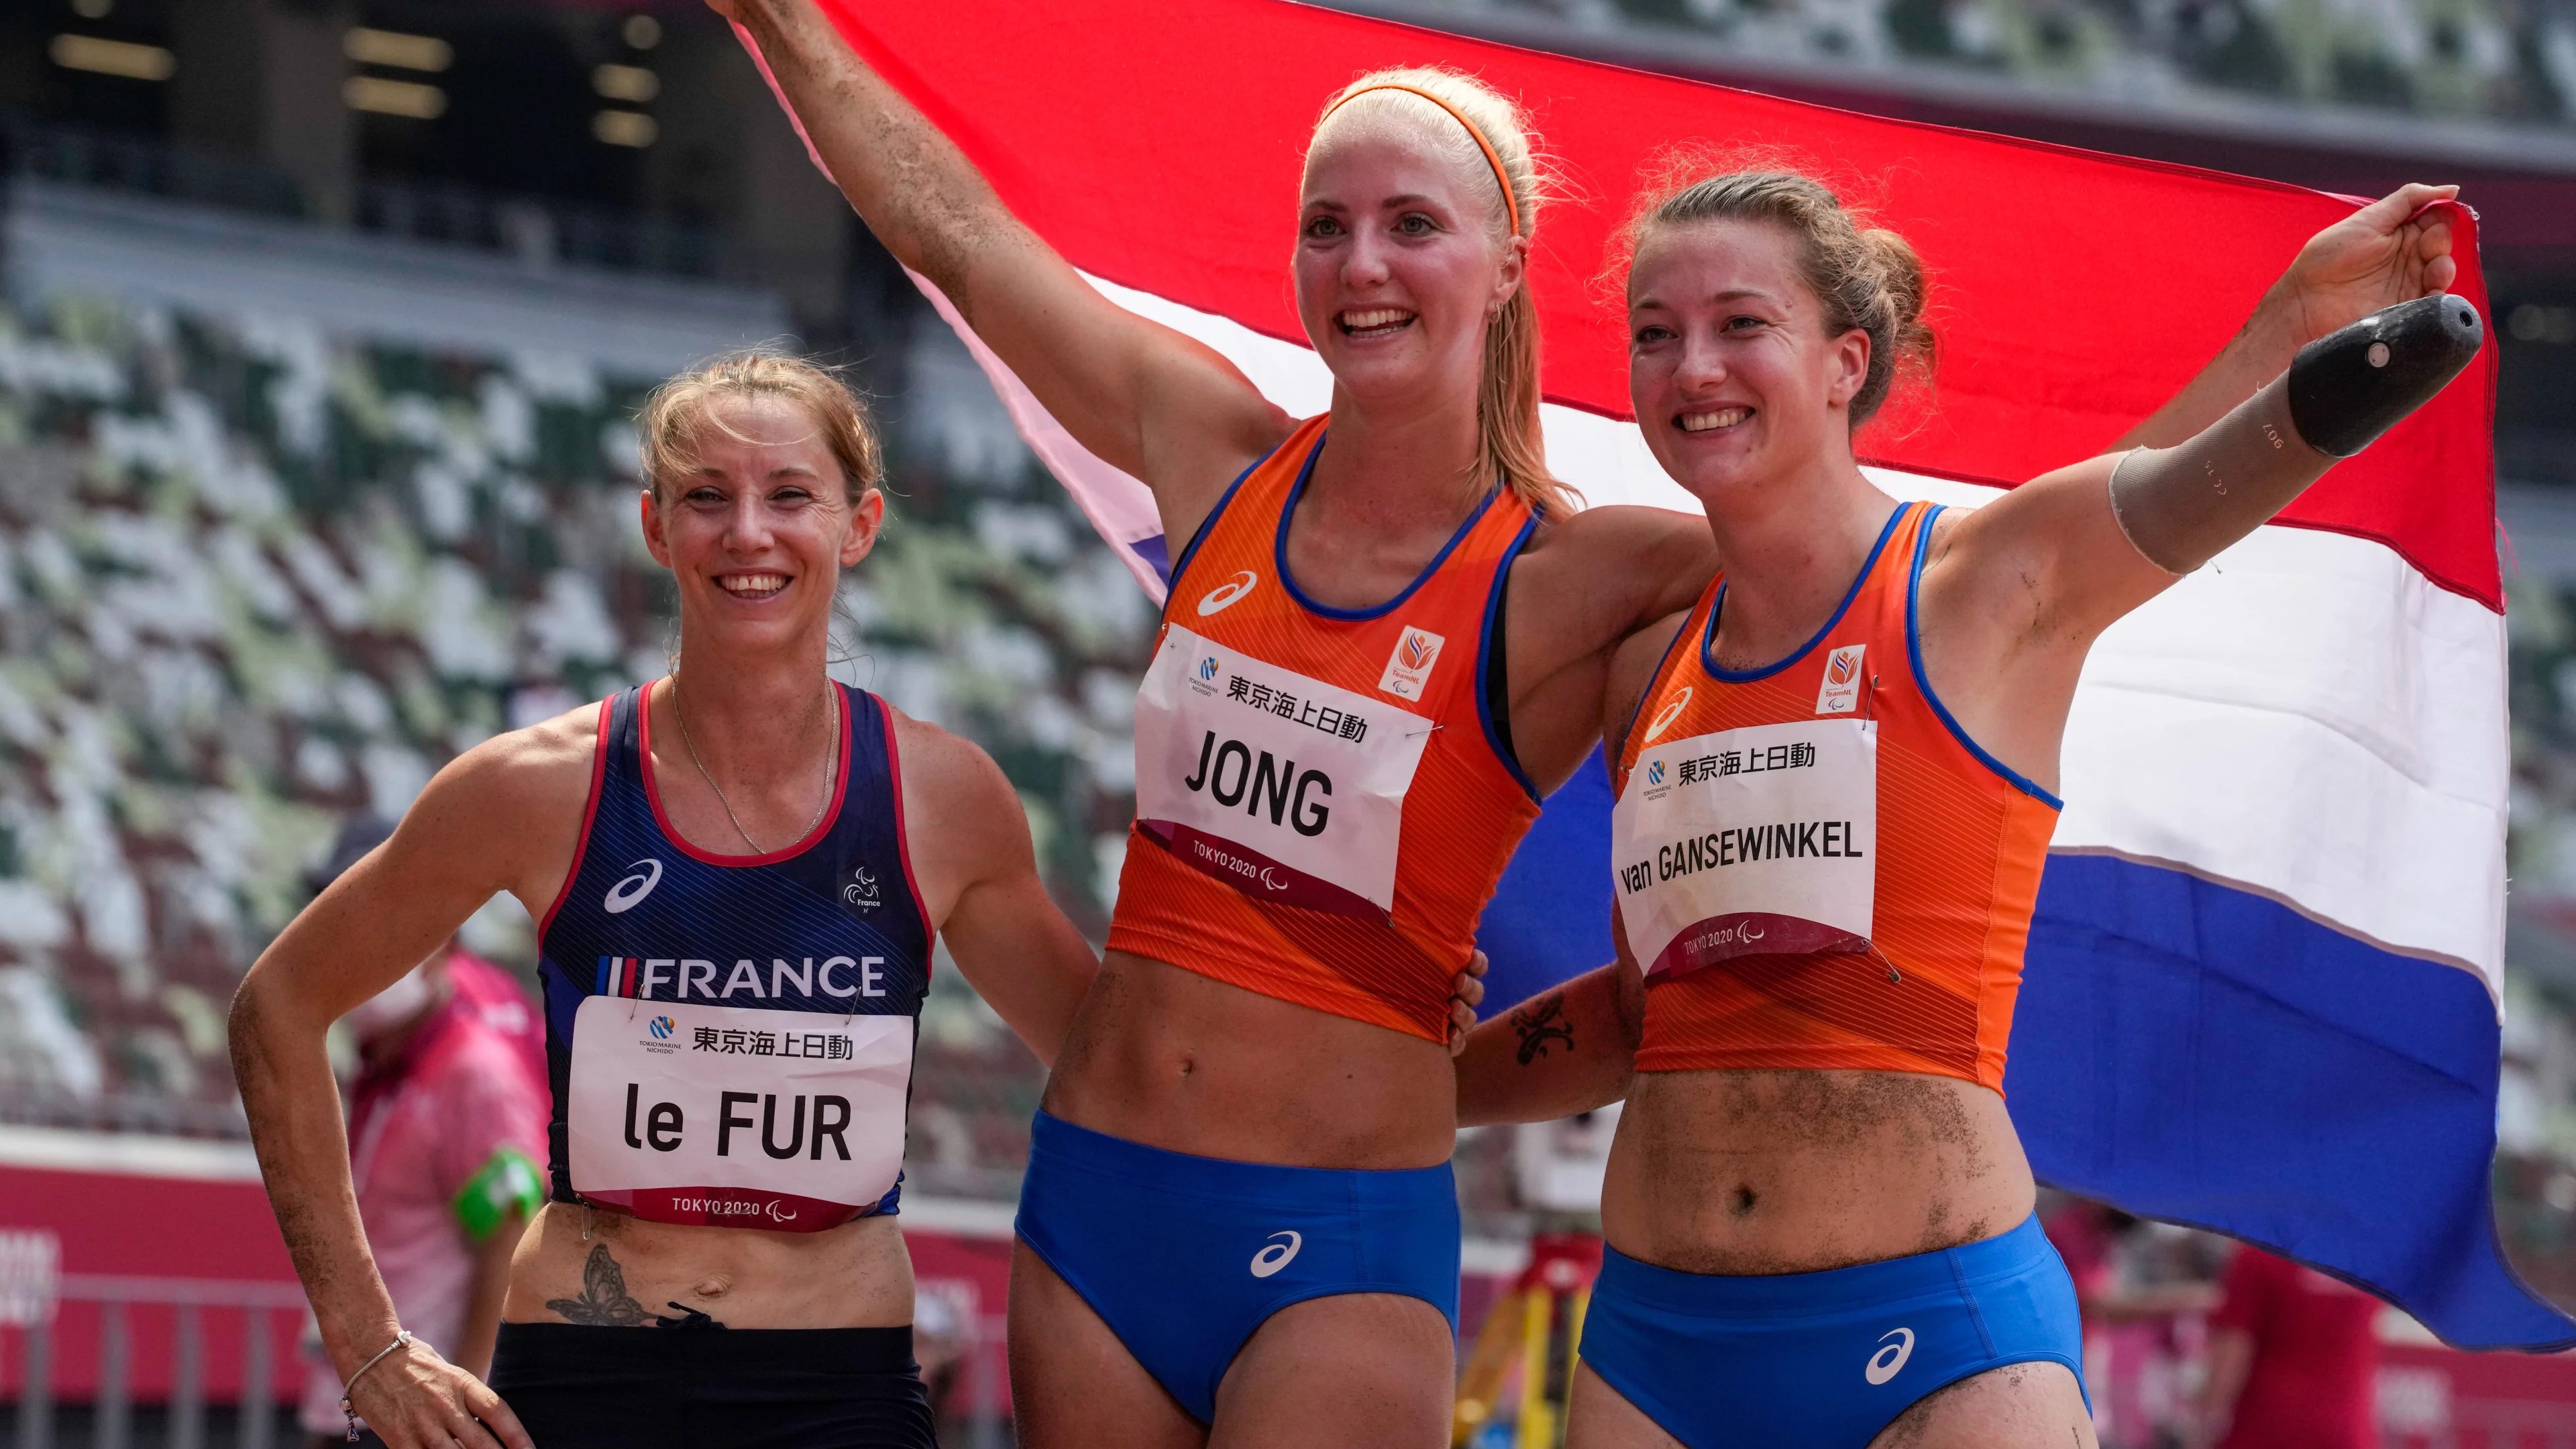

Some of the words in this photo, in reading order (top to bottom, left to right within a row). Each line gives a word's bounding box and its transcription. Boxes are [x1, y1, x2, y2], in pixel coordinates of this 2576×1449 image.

[2262, 423, 2284, 449] 907
[1192, 686, 1211, 696] NICHIDO
[1392, 669, 1420, 684] TeamNL
[1226, 675, 1367, 743] 東京海上日動
[1825, 689, 1852, 698] TeamNL
[1679, 742, 1815, 788] 東京海上日動
[1184, 730, 1333, 837] JONG
[1648, 792, 1666, 801] NICHIDO
[1194, 839, 1228, 866] TOKYO
[1228, 856, 1256, 878] 2020
[1621, 861, 1652, 895] van
[1658, 821, 1863, 881] GANSEWINKEL
[857, 899, 881, 907] France
[1684, 935, 1707, 955] TOKYO
[1708, 928, 1733, 947] 2020
[643, 956, 886, 999] FRANCE
[692, 1026, 853, 1061] 東京海上日動
[624, 1083, 684, 1152] le
[716, 1090, 852, 1161] FUR
[672, 1197, 720, 1212] TOKYO
[724, 1201, 760, 1216] 2020
